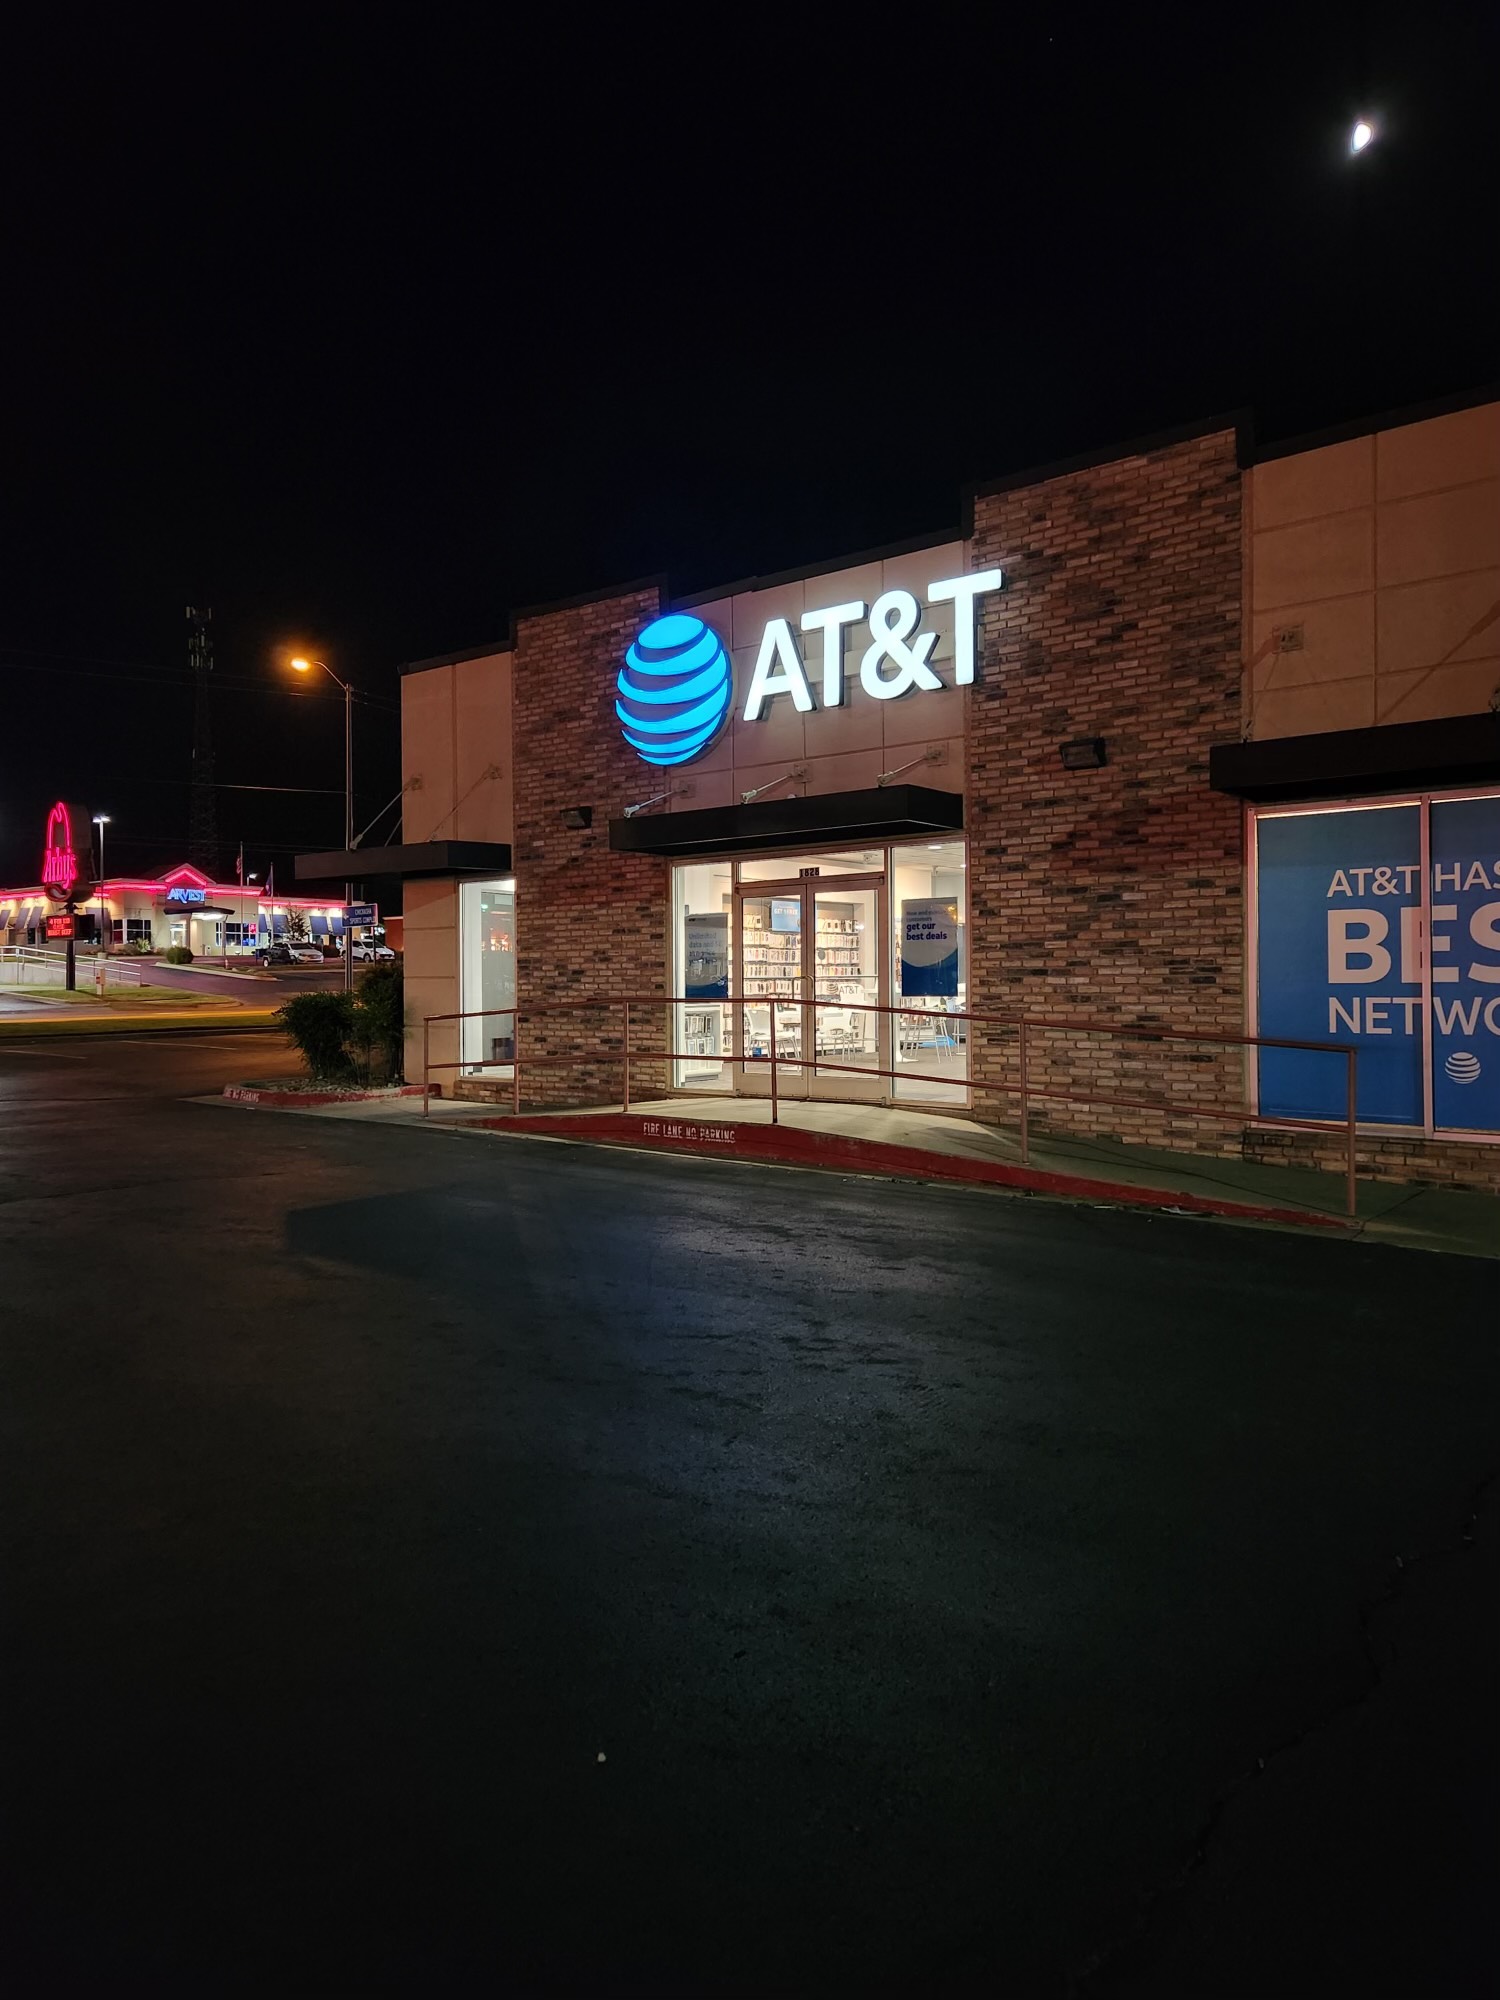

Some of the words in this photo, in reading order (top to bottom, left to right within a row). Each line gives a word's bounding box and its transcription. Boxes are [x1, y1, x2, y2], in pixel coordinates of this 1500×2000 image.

[743, 569, 1003, 721] AT&T
[43, 847, 78, 890] Arby's
[799, 867, 820, 877] 1828
[1327, 865, 1420, 897] AT&T
[167, 888, 205, 904] ARVEST
[906, 922, 920, 932] get
[906, 932, 924, 940] best
[925, 931, 948, 940] deals
[839, 985, 860, 994] AT&T
[643, 1122, 660, 1136] FIRE
[663, 1124, 683, 1138] LANE
[685, 1126, 698, 1140] NO
[699, 1127, 736, 1144] PARKING
